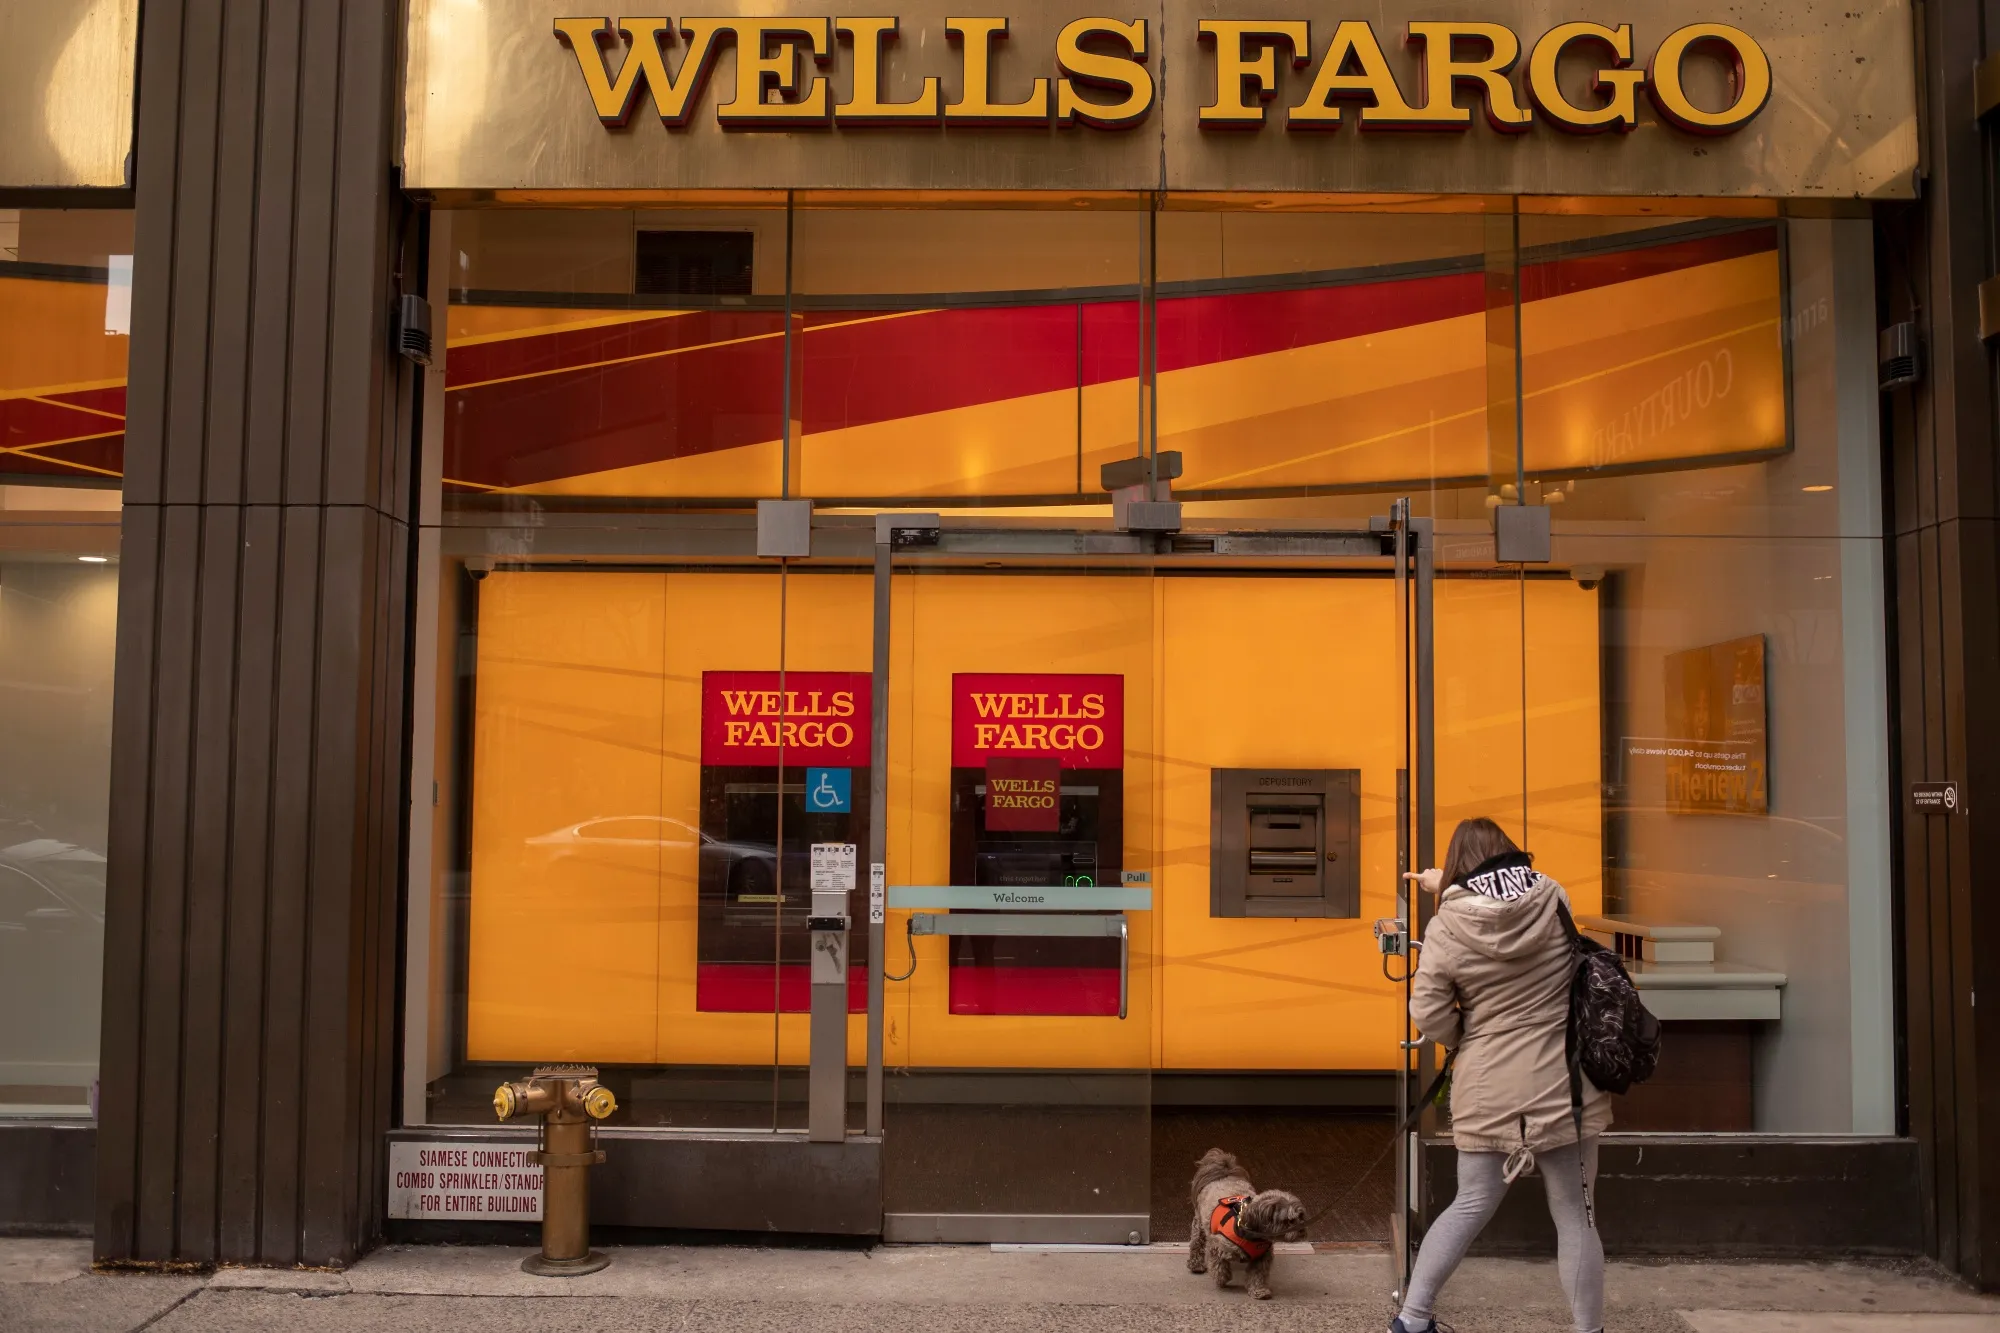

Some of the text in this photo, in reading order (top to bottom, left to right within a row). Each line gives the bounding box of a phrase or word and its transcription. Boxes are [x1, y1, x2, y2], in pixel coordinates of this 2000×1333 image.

[553, 17, 1772, 133] WELLS FARGO
[720, 690, 855, 717] WELLS
[970, 693, 1105, 719] WELLS
[723, 721, 854, 748] FARGO
[974, 724, 1104, 750] FARGO
[991, 779, 1055, 793] WELLS
[1259, 777, 1313, 787] DEPOSITORY
[1666, 766, 1700, 801] The
[992, 795, 1055, 809] FARGO
[1126, 873, 1146, 882] Pull
[993, 892, 1045, 903] Welcome
[420, 1150, 468, 1167] SIAMESE
[396, 1172, 435, 1189] COMBO
[420, 1195, 537, 1213] FOR ENTIRE BUILDING
